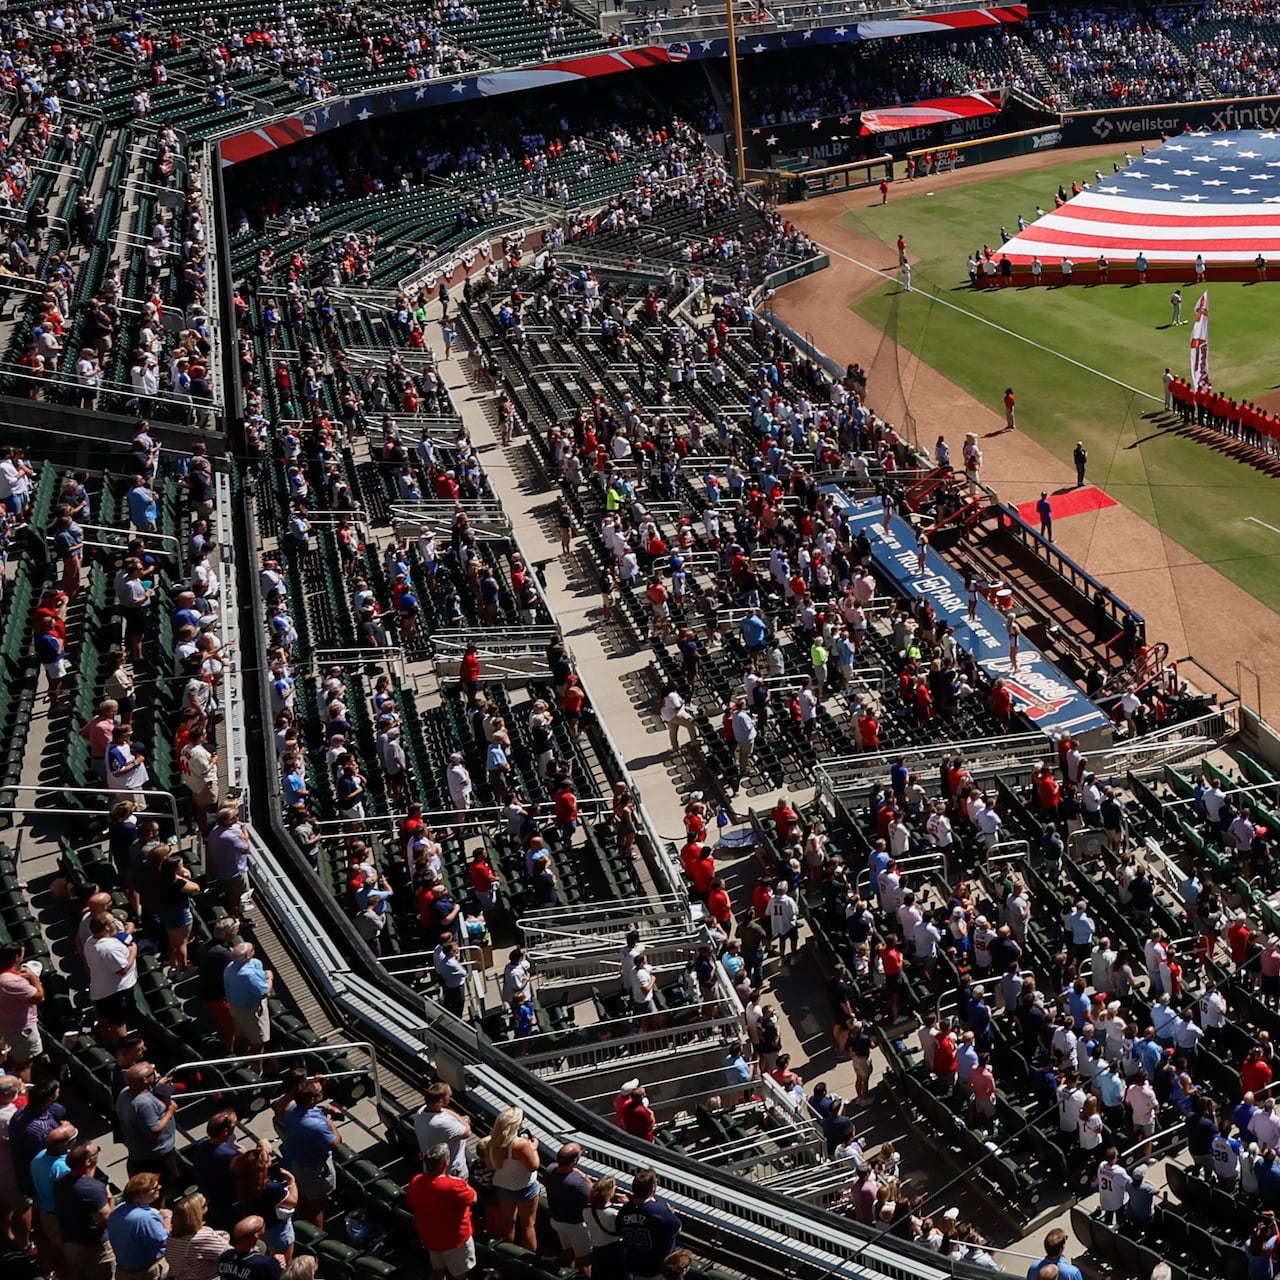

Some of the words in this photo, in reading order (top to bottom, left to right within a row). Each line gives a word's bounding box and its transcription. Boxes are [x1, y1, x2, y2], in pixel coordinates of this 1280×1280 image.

[966, 116, 997, 132] MLB+
[1116, 118, 1179, 134] Wellstar
[899, 128, 933, 144] MLB+
[813, 142, 849, 159] MLB+
[929, 584, 968, 614] PARK
[1214, 1150, 1229, 1162] 28
[1101, 1177, 1112, 1191] 31
[623, 1214, 646, 1225] SMOLTZ
